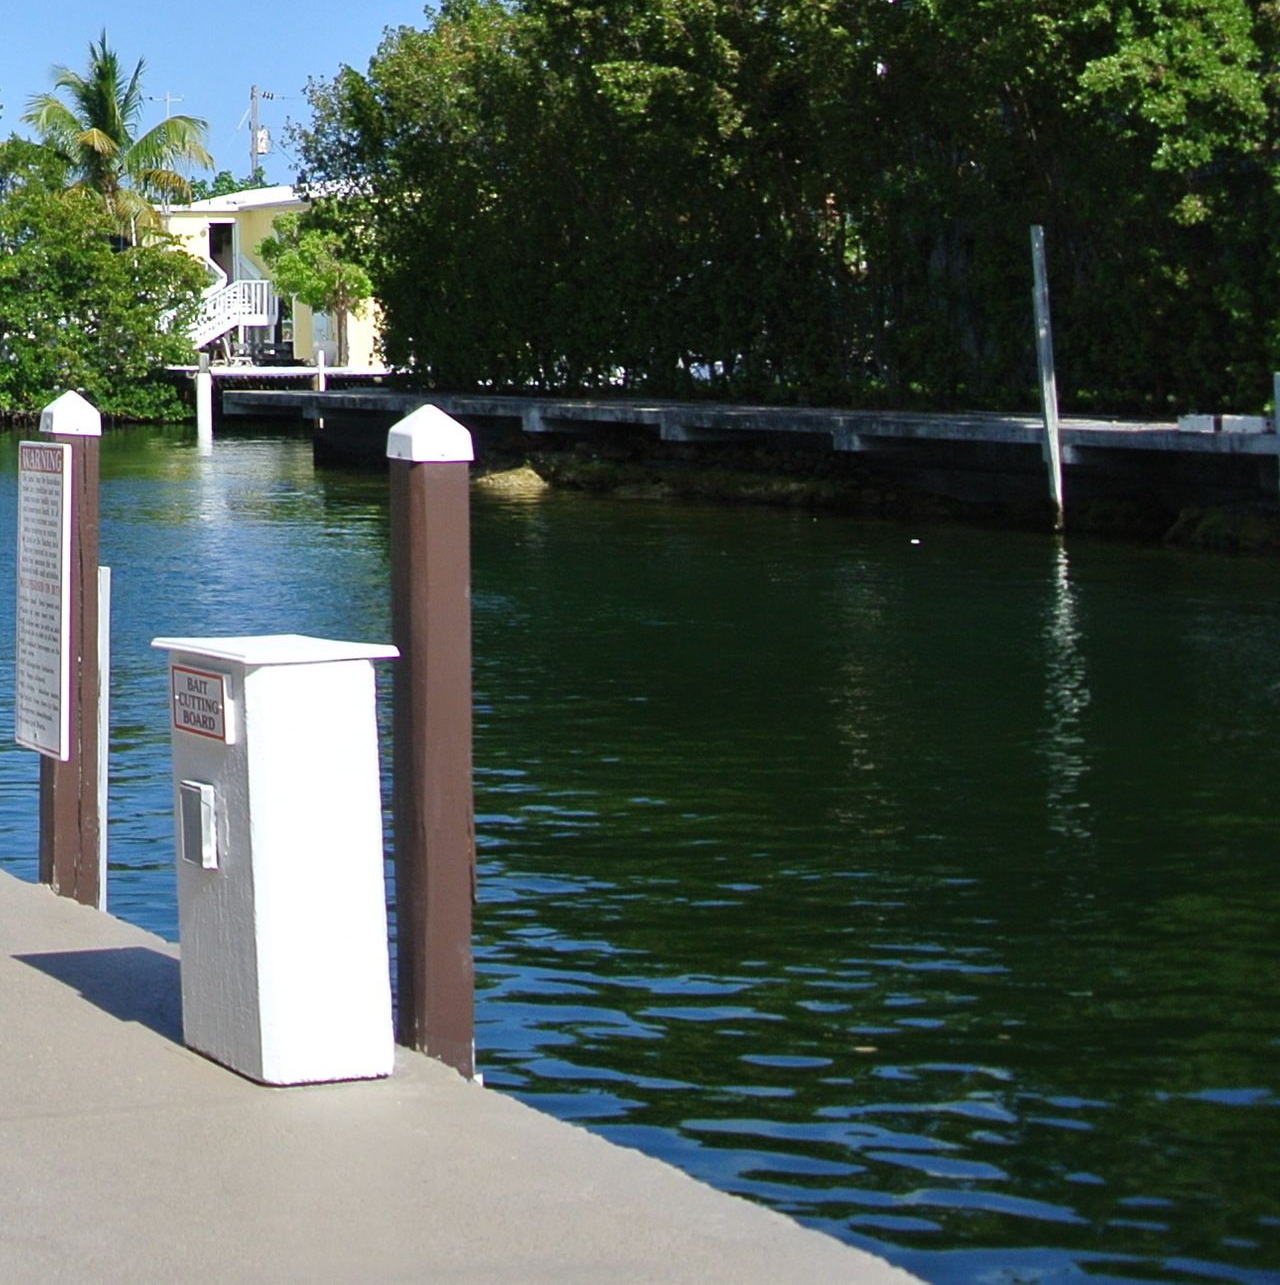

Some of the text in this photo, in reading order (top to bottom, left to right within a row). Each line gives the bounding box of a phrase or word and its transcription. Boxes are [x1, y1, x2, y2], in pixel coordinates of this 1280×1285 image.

[22, 448, 62, 472] WARNING
[187, 677, 208, 695] BAIT
[179, 692, 219, 715] CUTTING
[183, 710, 215, 730] BOARD
